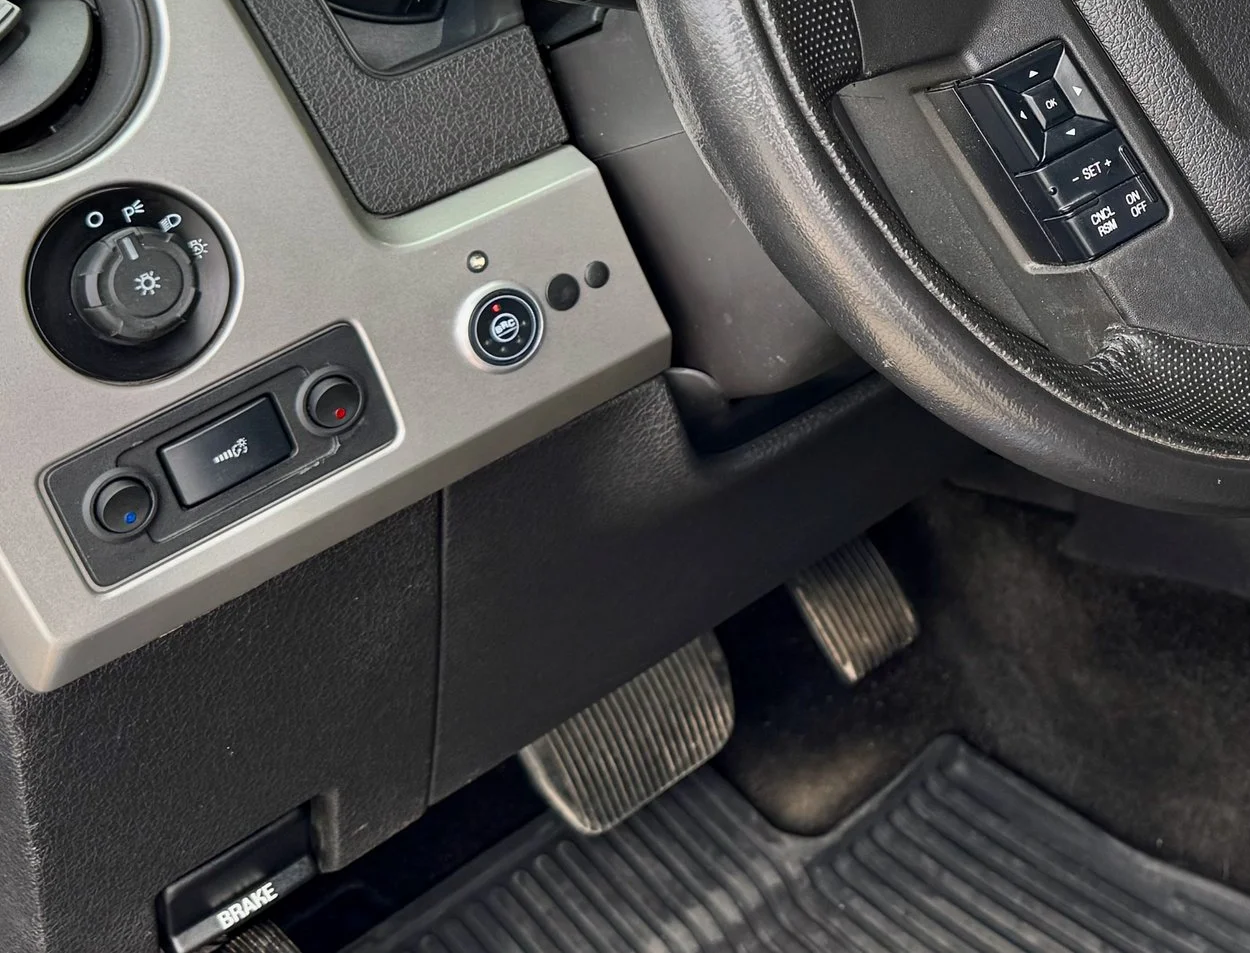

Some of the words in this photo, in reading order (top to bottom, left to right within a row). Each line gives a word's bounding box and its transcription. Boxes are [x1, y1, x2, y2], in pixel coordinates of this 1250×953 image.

[1045, 98, 1058, 110] OK
[1082, 162, 1102, 180] SET
[1125, 190, 1141, 205] ON
[1090, 205, 1116, 226] CNCL
[1130, 202, 1148, 218] OFF
[1097, 219, 1118, 237] RSM
[494, 318, 516, 335] BRC
[216, 881, 279, 930] BRAKE
